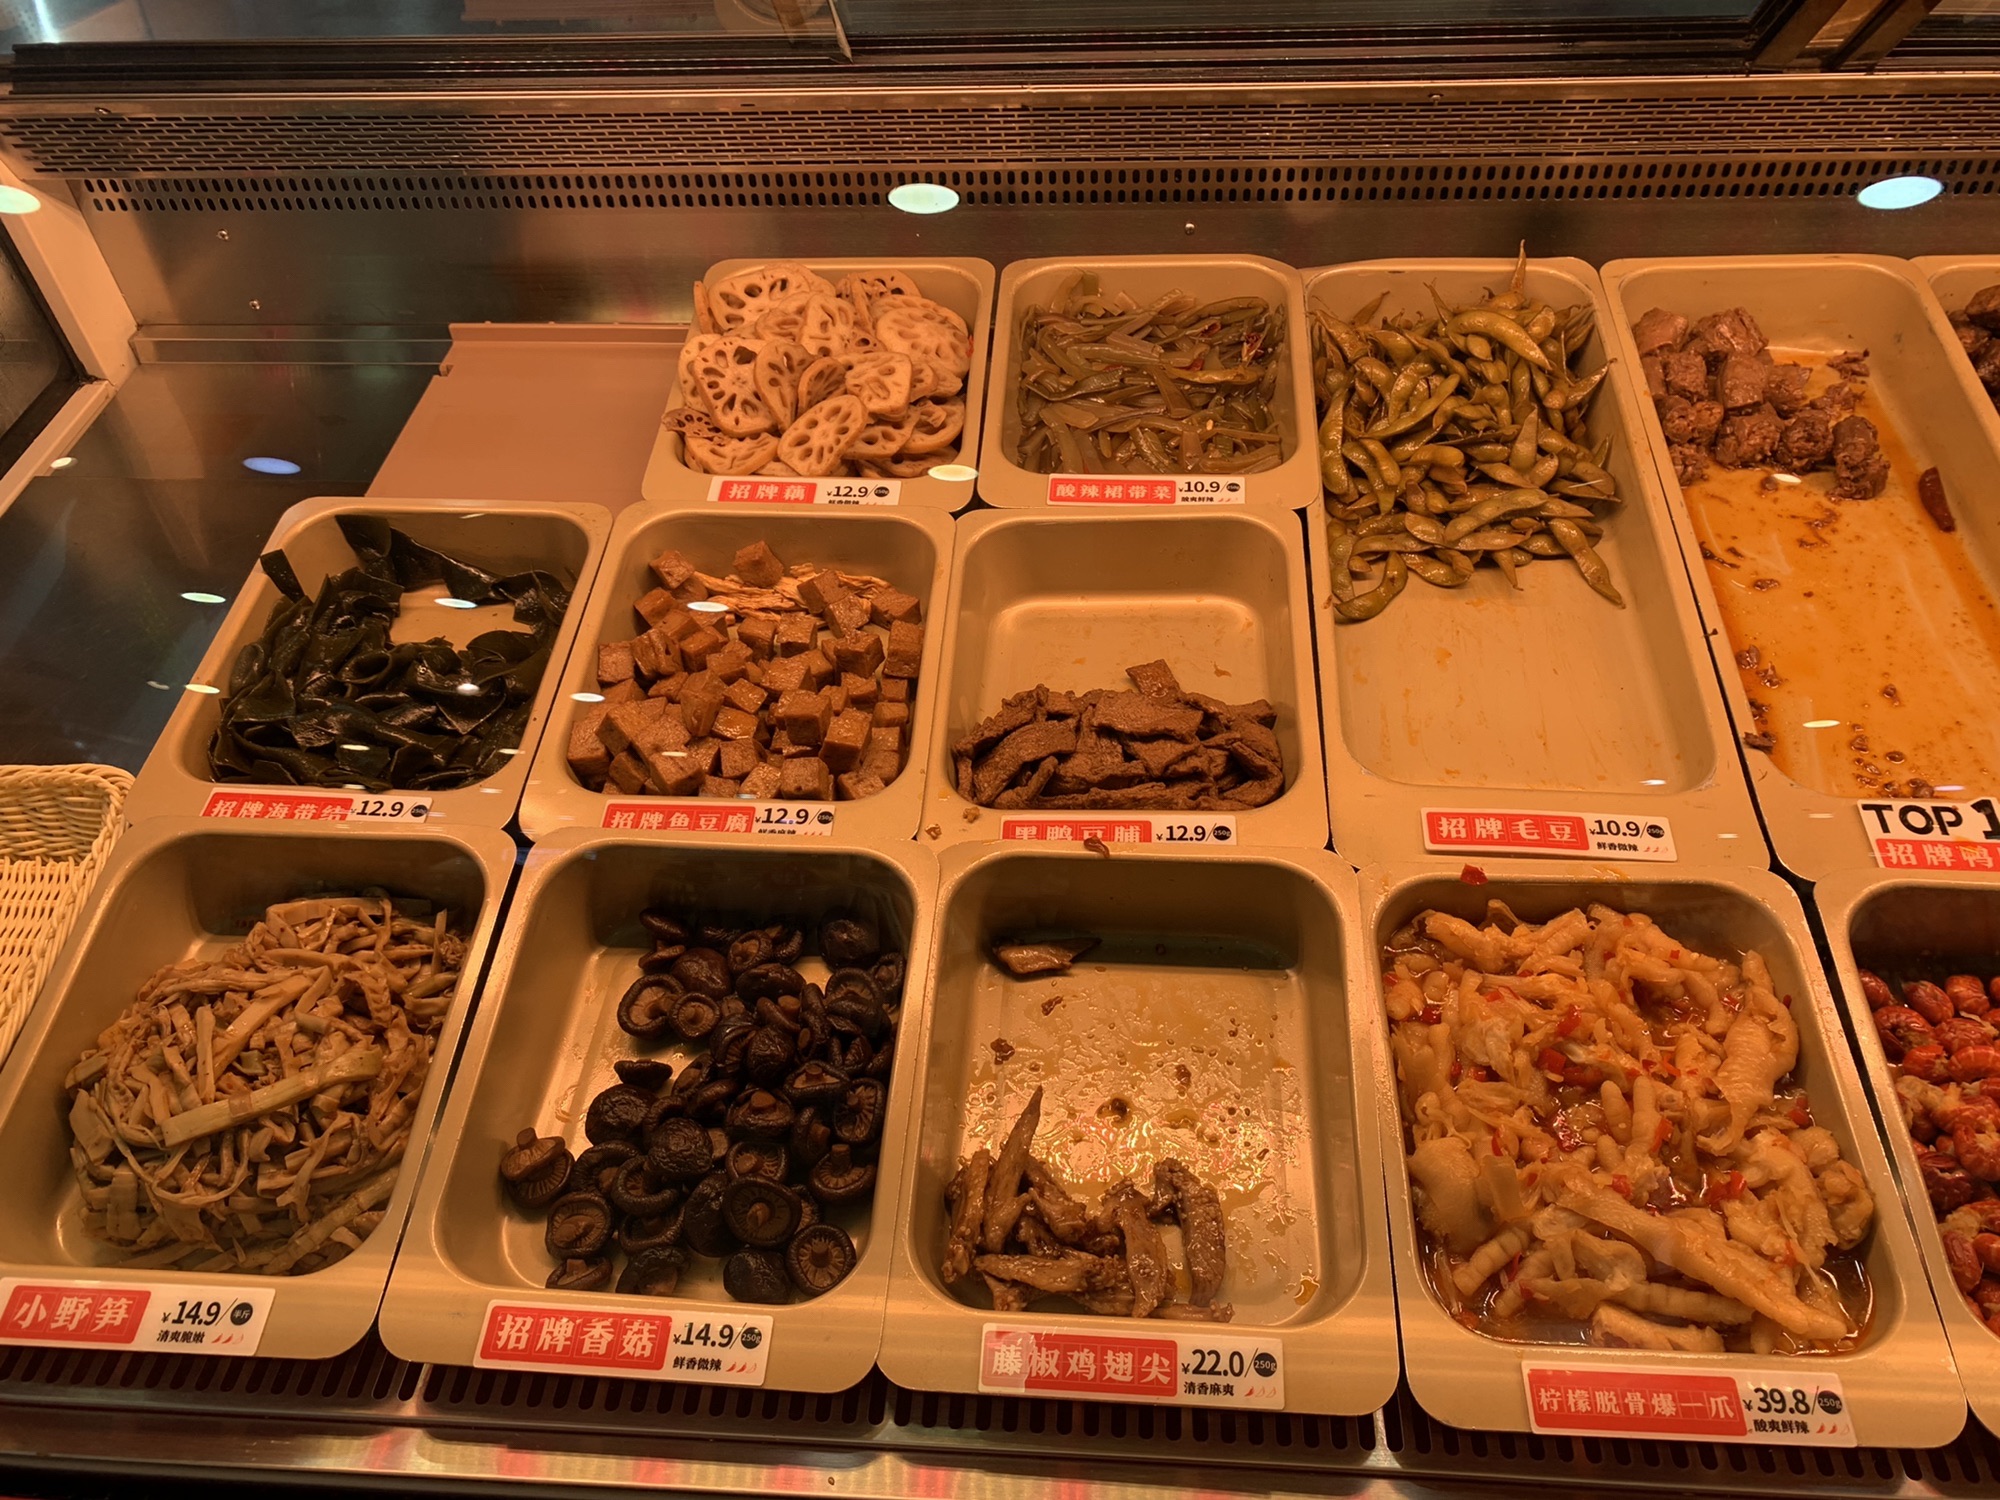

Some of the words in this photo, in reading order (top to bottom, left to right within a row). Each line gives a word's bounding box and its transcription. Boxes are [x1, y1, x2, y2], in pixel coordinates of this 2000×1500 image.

[729, 482, 806, 501] 招牌藕
[1056, 483, 1172, 500] 酸辣裙带菜
[210, 799, 345, 822] 招牌海带结
[610, 810, 750, 832] 招牌鱼豆腐
[1437, 816, 1579, 843] 招牌毛豆
[1596, 841, 1639, 852] 鲜香微辣
[1885, 841, 2000, 869] 招牌鸭
[13, 1293, 134, 1333] 小野笋
[496, 1313, 659, 1358] 招牌香菇
[672, 1355, 723, 1372] 鲜香微辣
[990, 1343, 1172, 1386] 藤椒鸡翅尖
[1183, 1381, 1235, 1397] 清香麻爽
[1538, 1386, 1735, 1419] 柠檬脱骨爆一爪
[1752, 1417, 1811, 1435] 酸爽鲜辣
